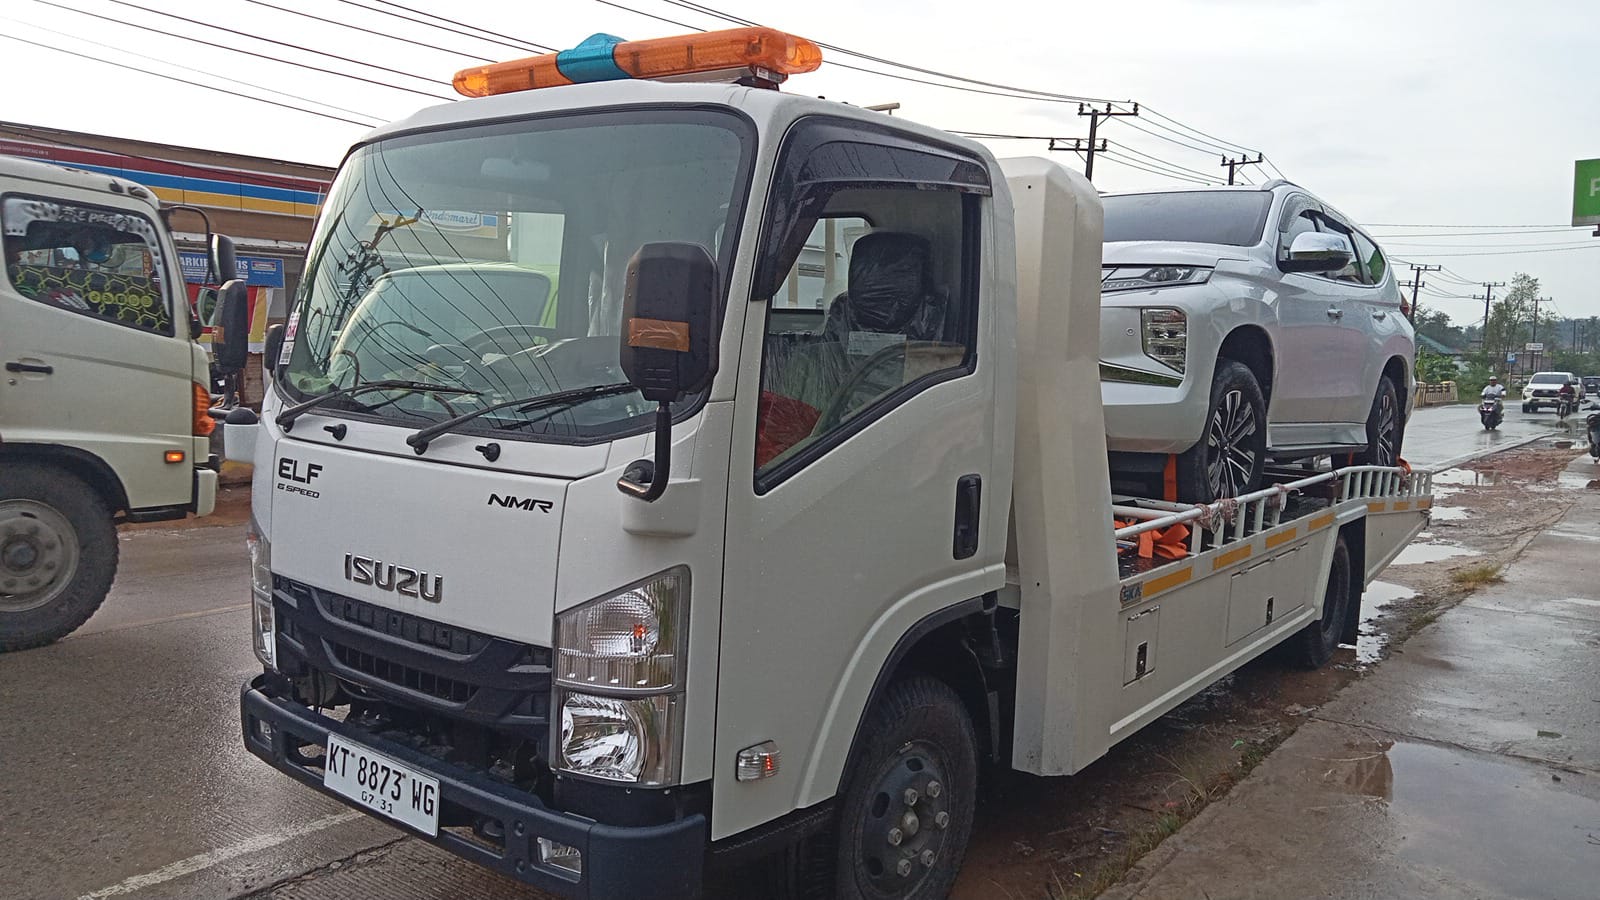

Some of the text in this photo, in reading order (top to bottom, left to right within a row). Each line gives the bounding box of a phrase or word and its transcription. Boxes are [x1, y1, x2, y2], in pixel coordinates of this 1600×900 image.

[278, 457, 323, 484] ELF
[286, 485, 320, 499] SPEED
[488, 493, 554, 513] NMR
[344, 552, 443, 604] ISUZU
[329, 743, 435, 817] KT 8873 WG
